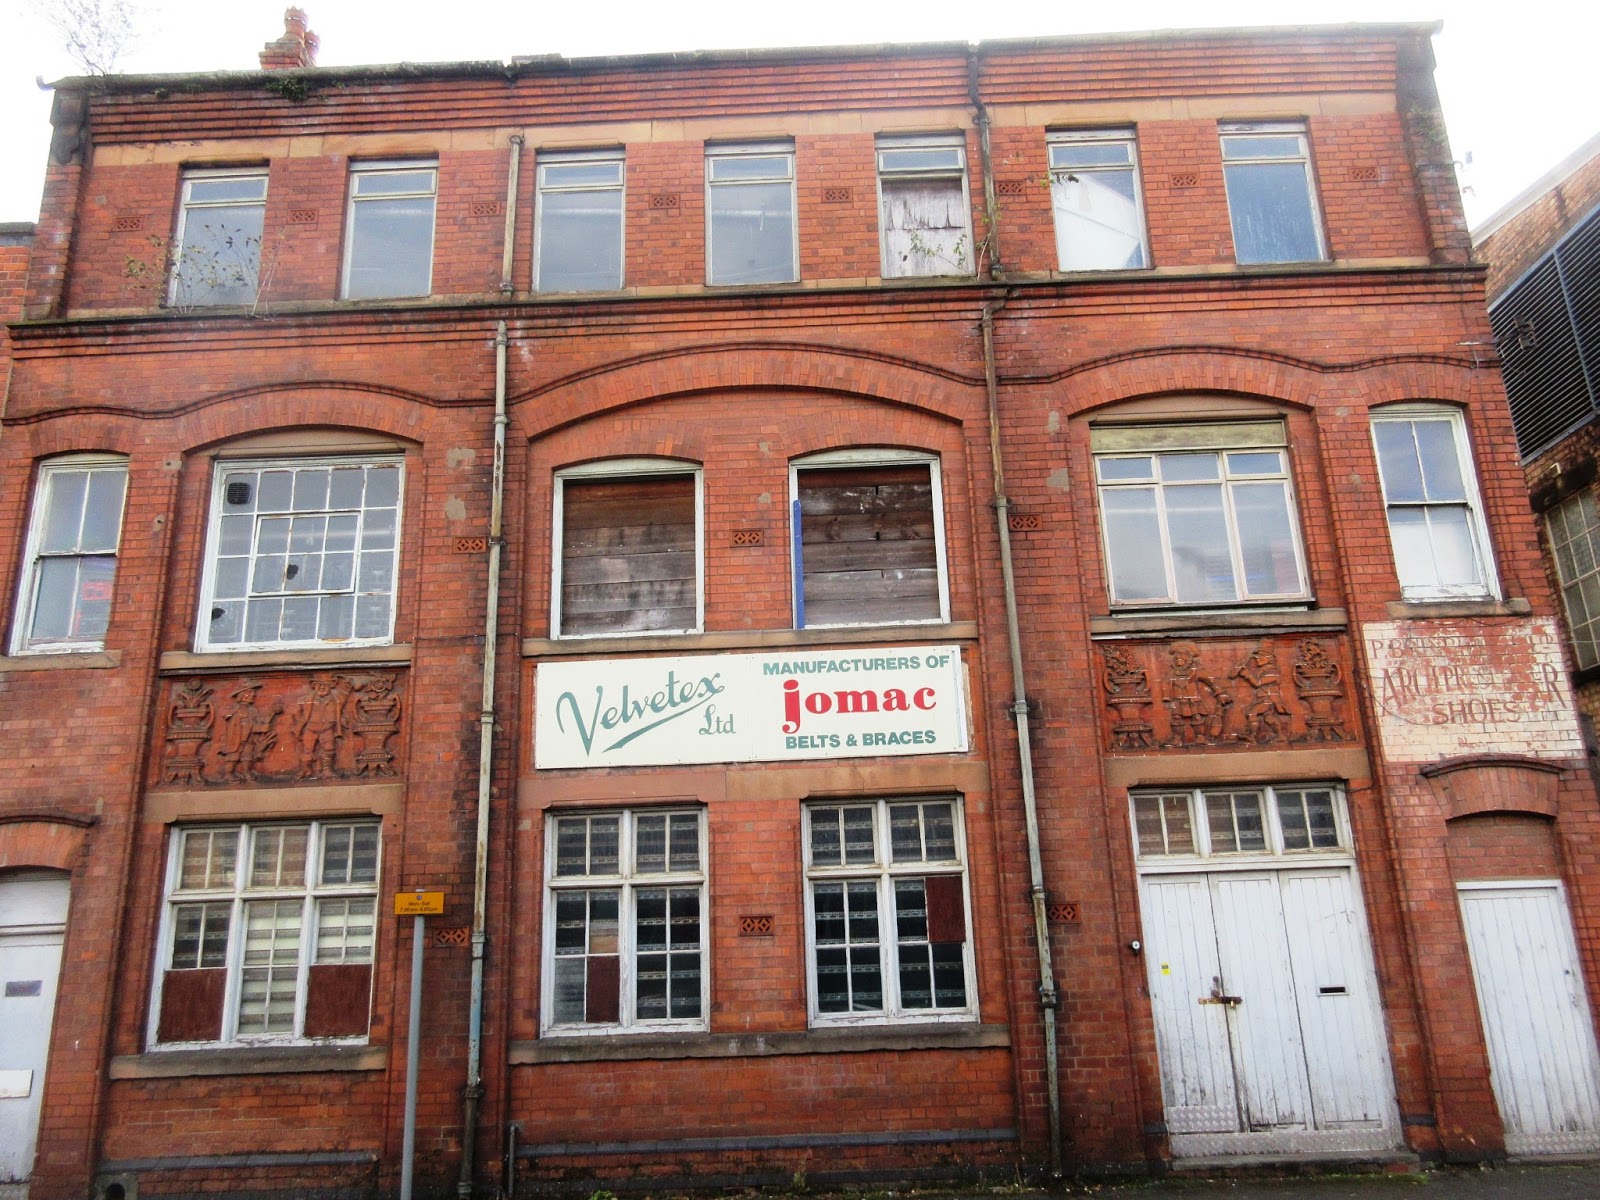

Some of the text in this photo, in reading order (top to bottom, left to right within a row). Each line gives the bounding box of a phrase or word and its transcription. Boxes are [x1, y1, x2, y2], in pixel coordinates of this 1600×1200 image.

[762, 655, 949, 676] MANUFACTURERS OF
[555, 670, 725, 757] Velvetex
[698, 703, 736, 735] Ltd
[781, 679, 937, 734] jomac
[1432, 697, 1521, 724] SHOES
[785, 730, 937, 750] BELTS & BRACES
